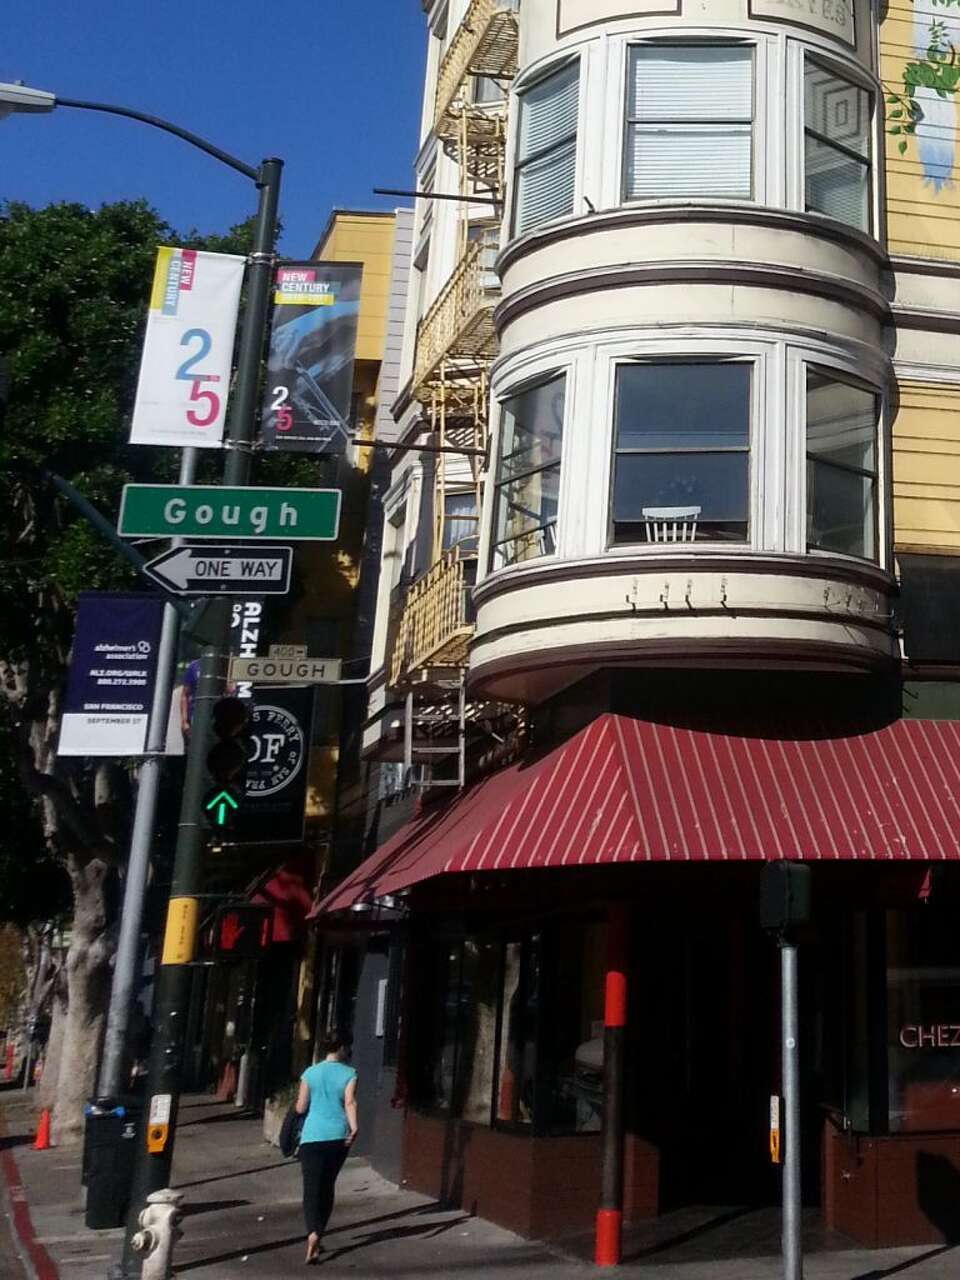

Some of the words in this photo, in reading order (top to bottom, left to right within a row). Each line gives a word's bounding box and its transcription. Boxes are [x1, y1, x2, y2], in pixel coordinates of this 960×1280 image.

[181, 260, 194, 287] NEW
[282, 272, 308, 282] NEW
[164, 259, 181, 307] CENTURY
[281, 282, 330, 293] CENTURY
[163, 497, 299, 534] Gough
[195, 560, 231, 577] ONE
[240, 561, 278, 577] WAY
[247, 663, 325, 677] GOUGH
[83, 703, 100, 711] SAN
[101, 703, 144, 711] FRANCISCO
[87, 717, 131, 725] SEPTEMBER
